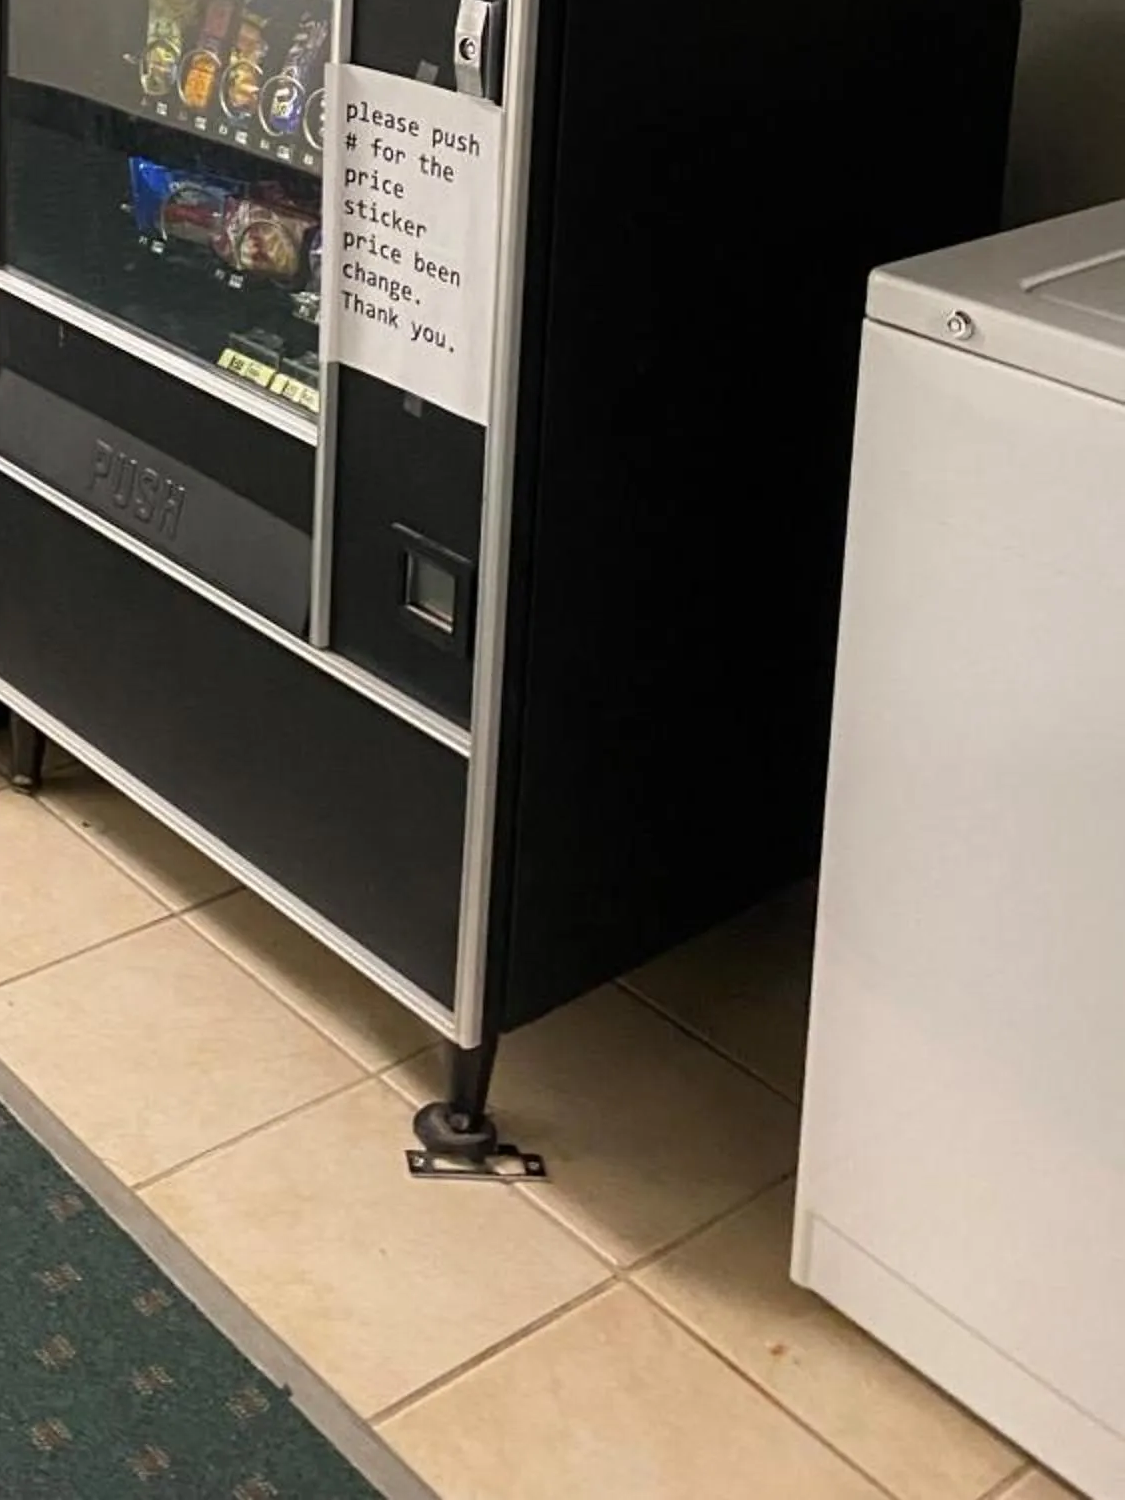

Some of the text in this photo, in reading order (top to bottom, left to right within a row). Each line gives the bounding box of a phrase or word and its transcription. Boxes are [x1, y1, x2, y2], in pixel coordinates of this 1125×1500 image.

[346, 101, 481, 157] please push
[344, 168, 405, 198] price
[345, 132, 455, 183] # for the
[344, 199, 428, 238] sticker
[342, 261, 421, 305] change.
[343, 231, 461, 288] price been
[341, 289, 455, 353] Thank you.
[89, 438, 186, 538] PUSH
